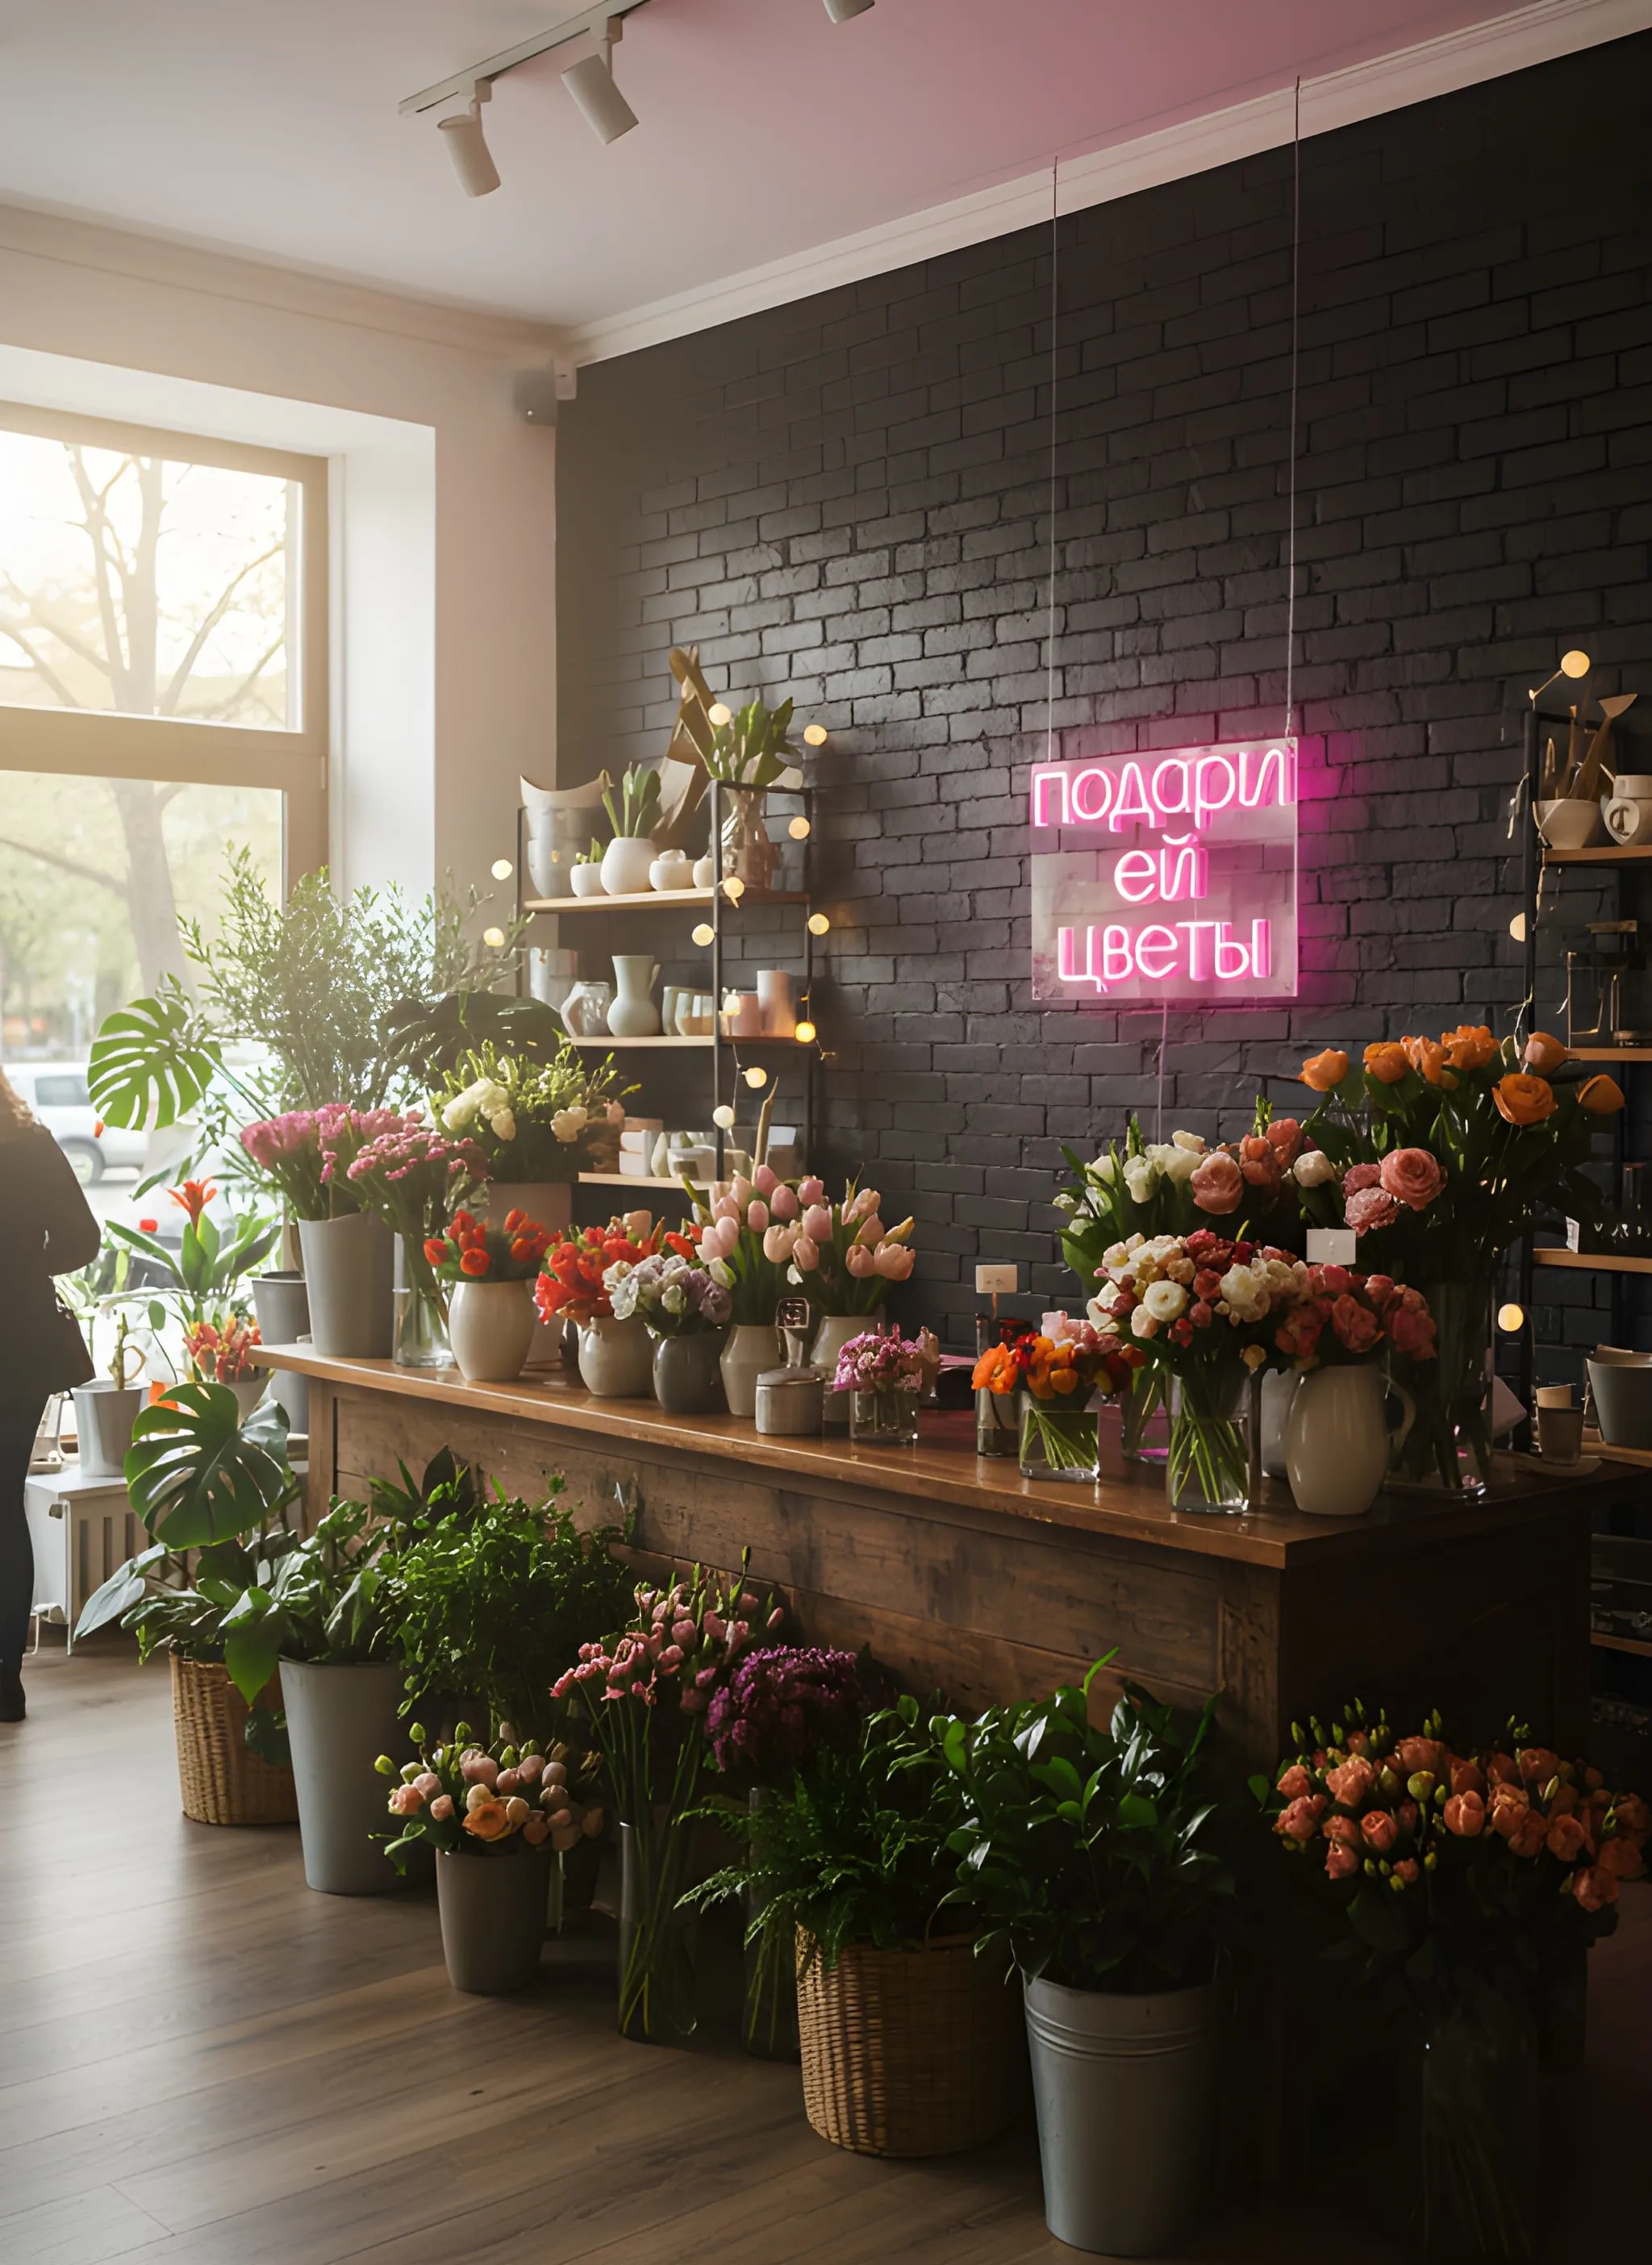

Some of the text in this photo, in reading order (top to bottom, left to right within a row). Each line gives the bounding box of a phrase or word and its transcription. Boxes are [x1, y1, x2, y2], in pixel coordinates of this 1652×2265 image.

[1033, 749, 1292, 832] подари
[1114, 832, 1202, 902] ей
[1058, 919, 1271, 993] цветы
